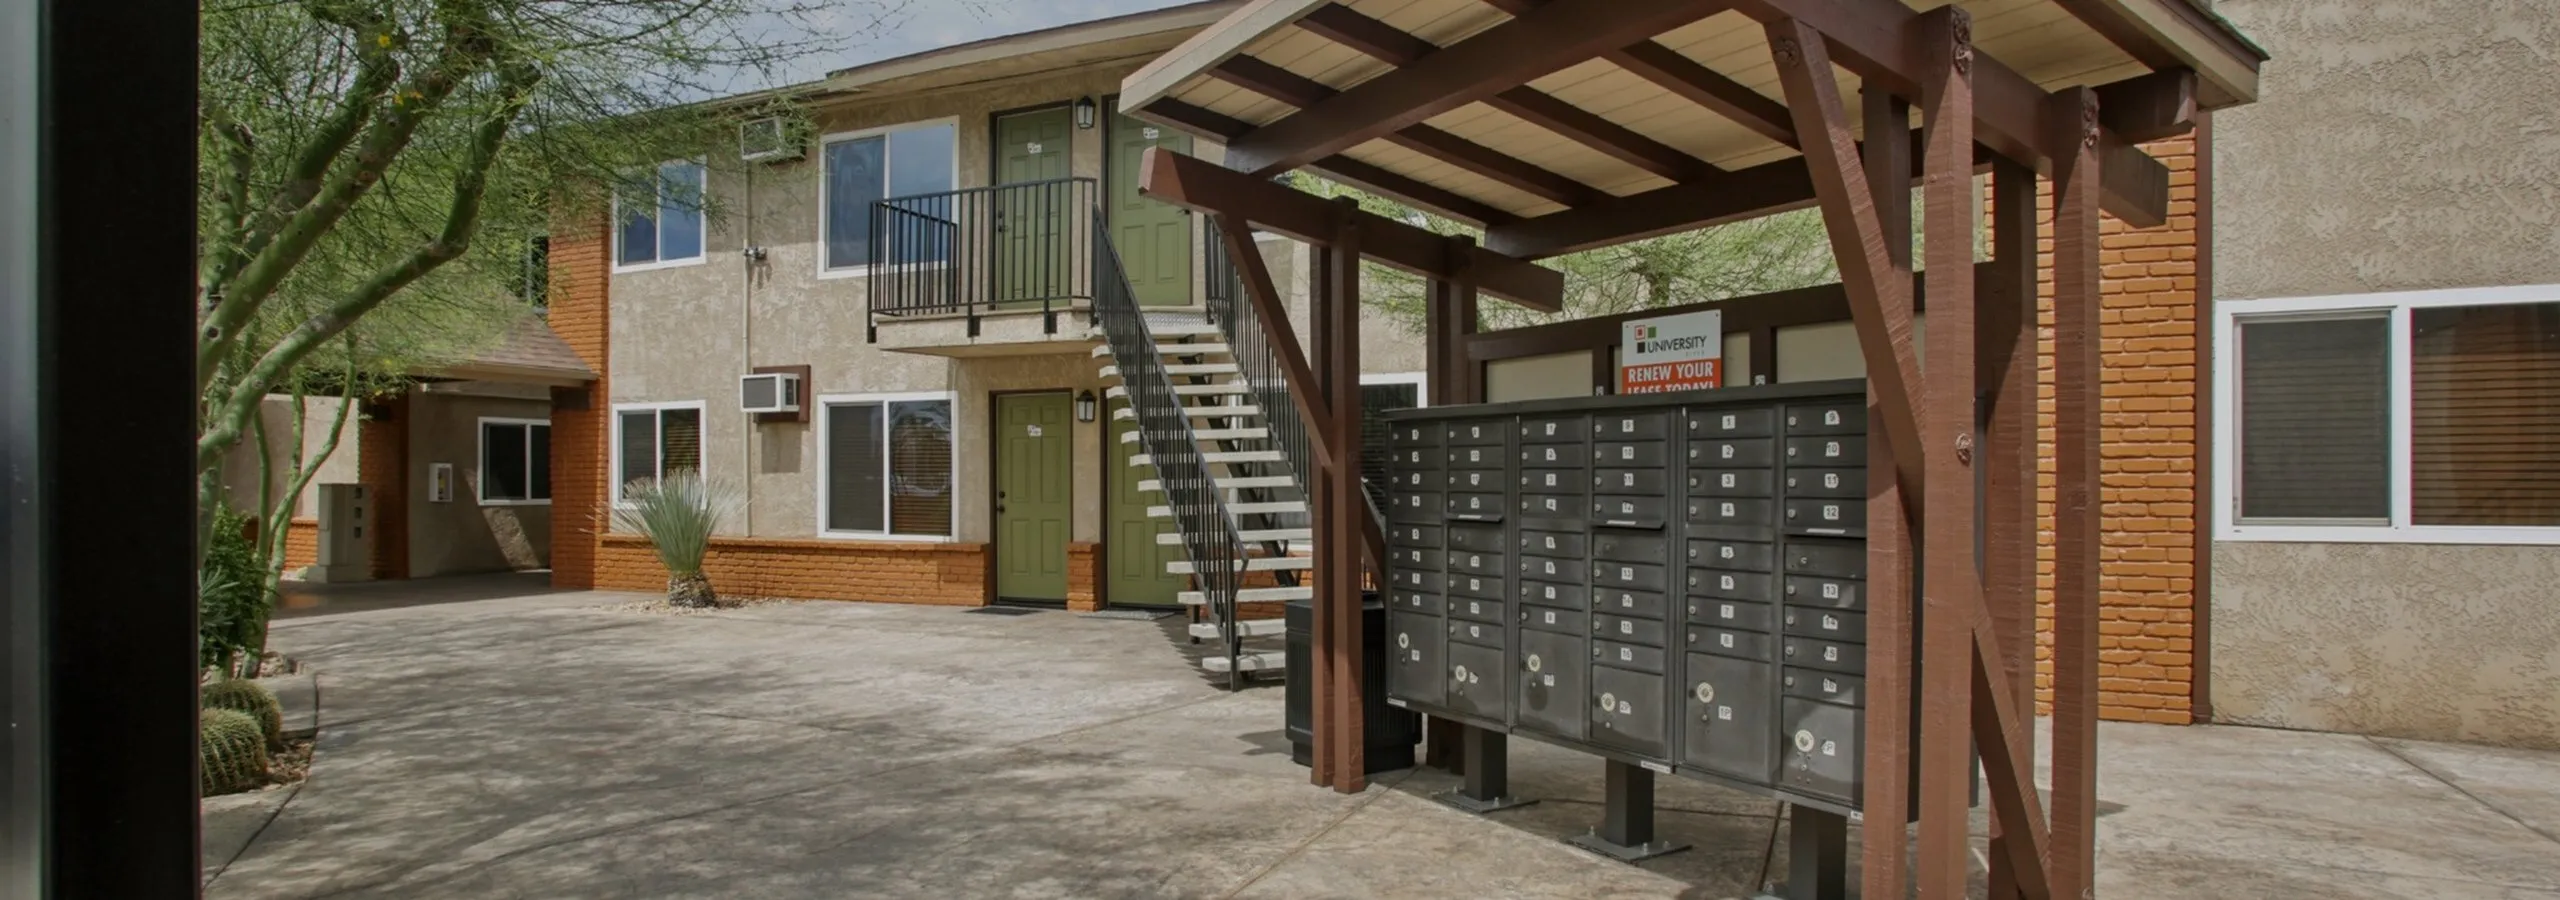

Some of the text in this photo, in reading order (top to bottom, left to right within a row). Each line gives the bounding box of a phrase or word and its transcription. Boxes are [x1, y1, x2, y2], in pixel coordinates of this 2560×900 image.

[1648, 336, 1707, 353] UNIVERSITY
[1628, 362, 1714, 383] RENEW YOUR
[1825, 443, 1838, 455] 10
[1826, 474, 1838, 486] 11
[1825, 506, 1838, 517] 12
[1825, 585, 1837, 597] 13
[1719, 706, 1733, 718] 1P
